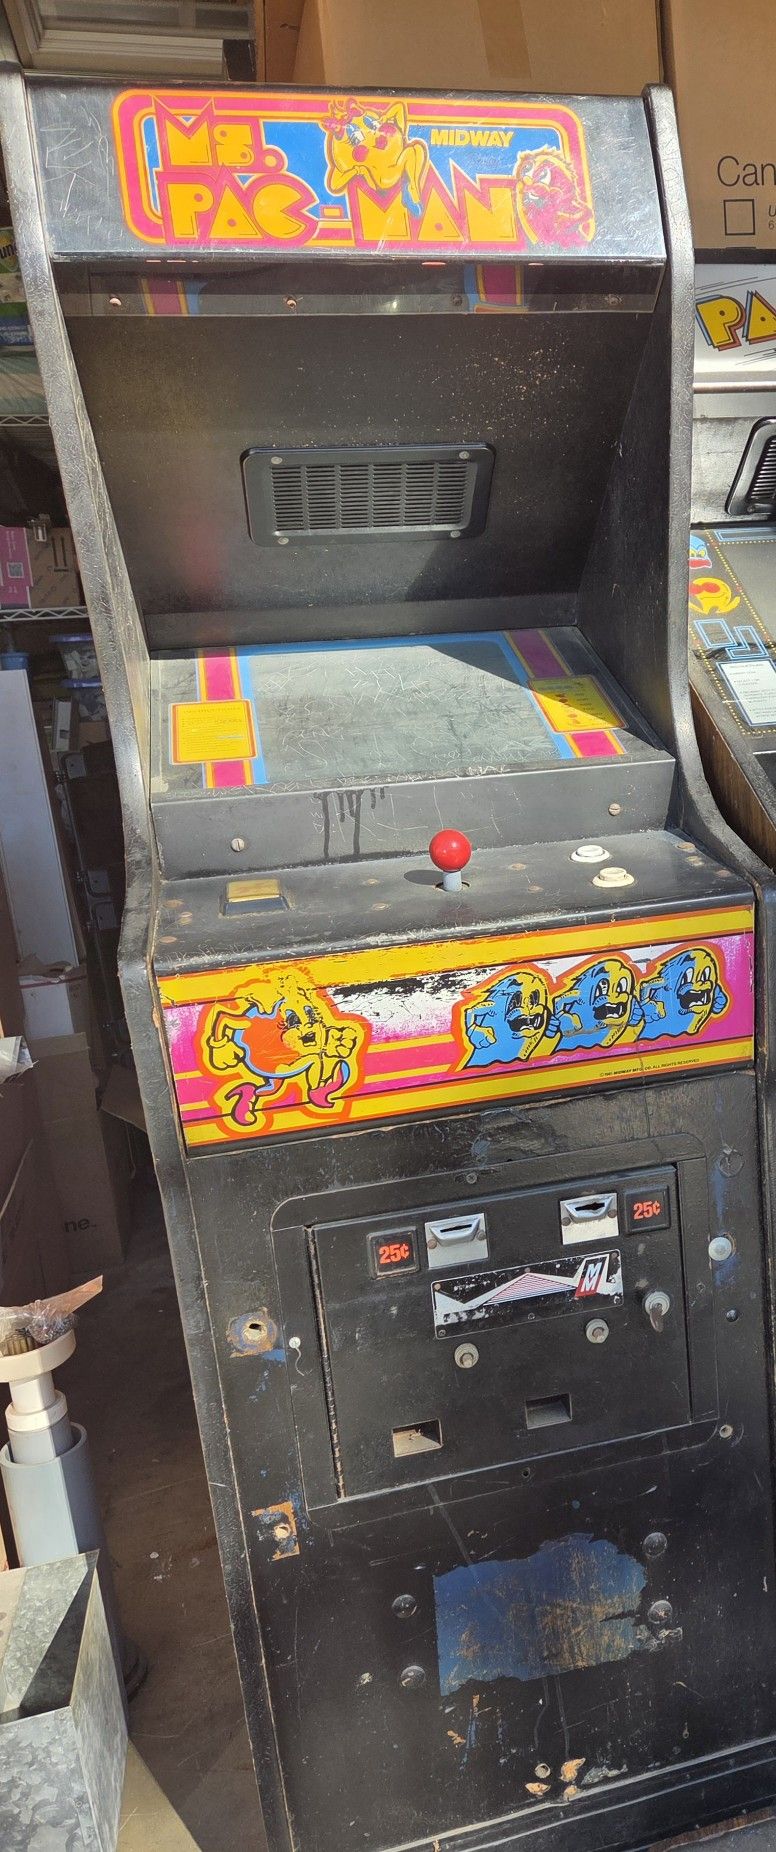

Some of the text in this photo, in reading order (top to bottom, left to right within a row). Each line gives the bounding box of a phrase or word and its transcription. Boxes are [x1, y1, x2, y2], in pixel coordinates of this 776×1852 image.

[429, 128, 514, 149] MIDWAY
[162, 176, 517, 245] PAC-MAN
[633, 1200, 661, 1220] 25¢
[378, 1243, 410, 1264] 25¢
